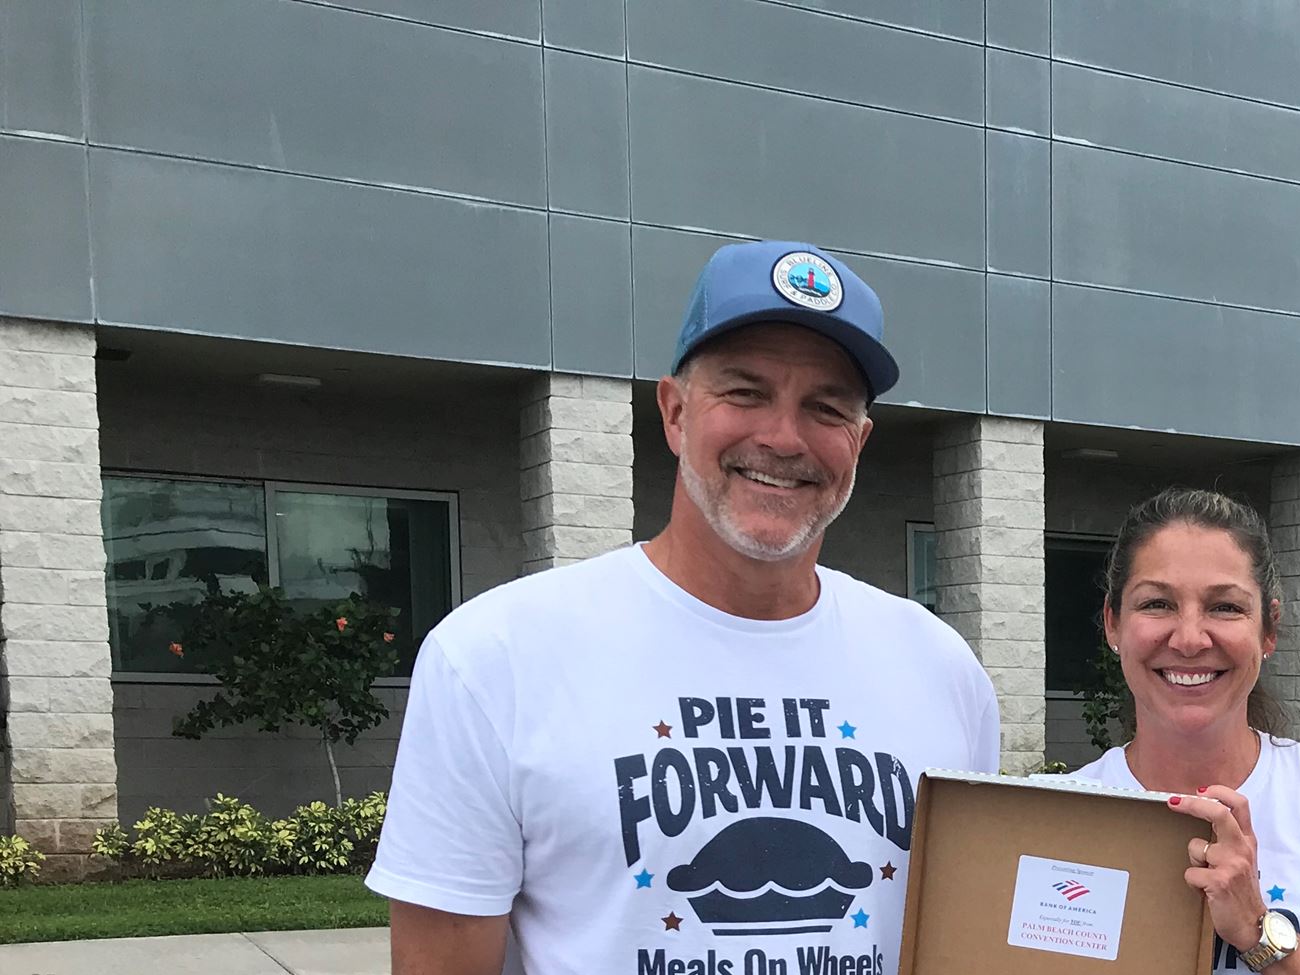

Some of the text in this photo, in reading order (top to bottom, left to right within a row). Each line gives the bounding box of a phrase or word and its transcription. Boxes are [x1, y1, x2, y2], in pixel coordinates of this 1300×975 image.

[678, 697, 830, 739] PIE IT
[614, 745, 917, 868] FORWARD
[1068, 906, 1096, 914] AMERICA
[1022, 922, 1107, 940] PALM BEACH COUNTY
[1021, 932, 1107, 950] CONVENTION CENTER
